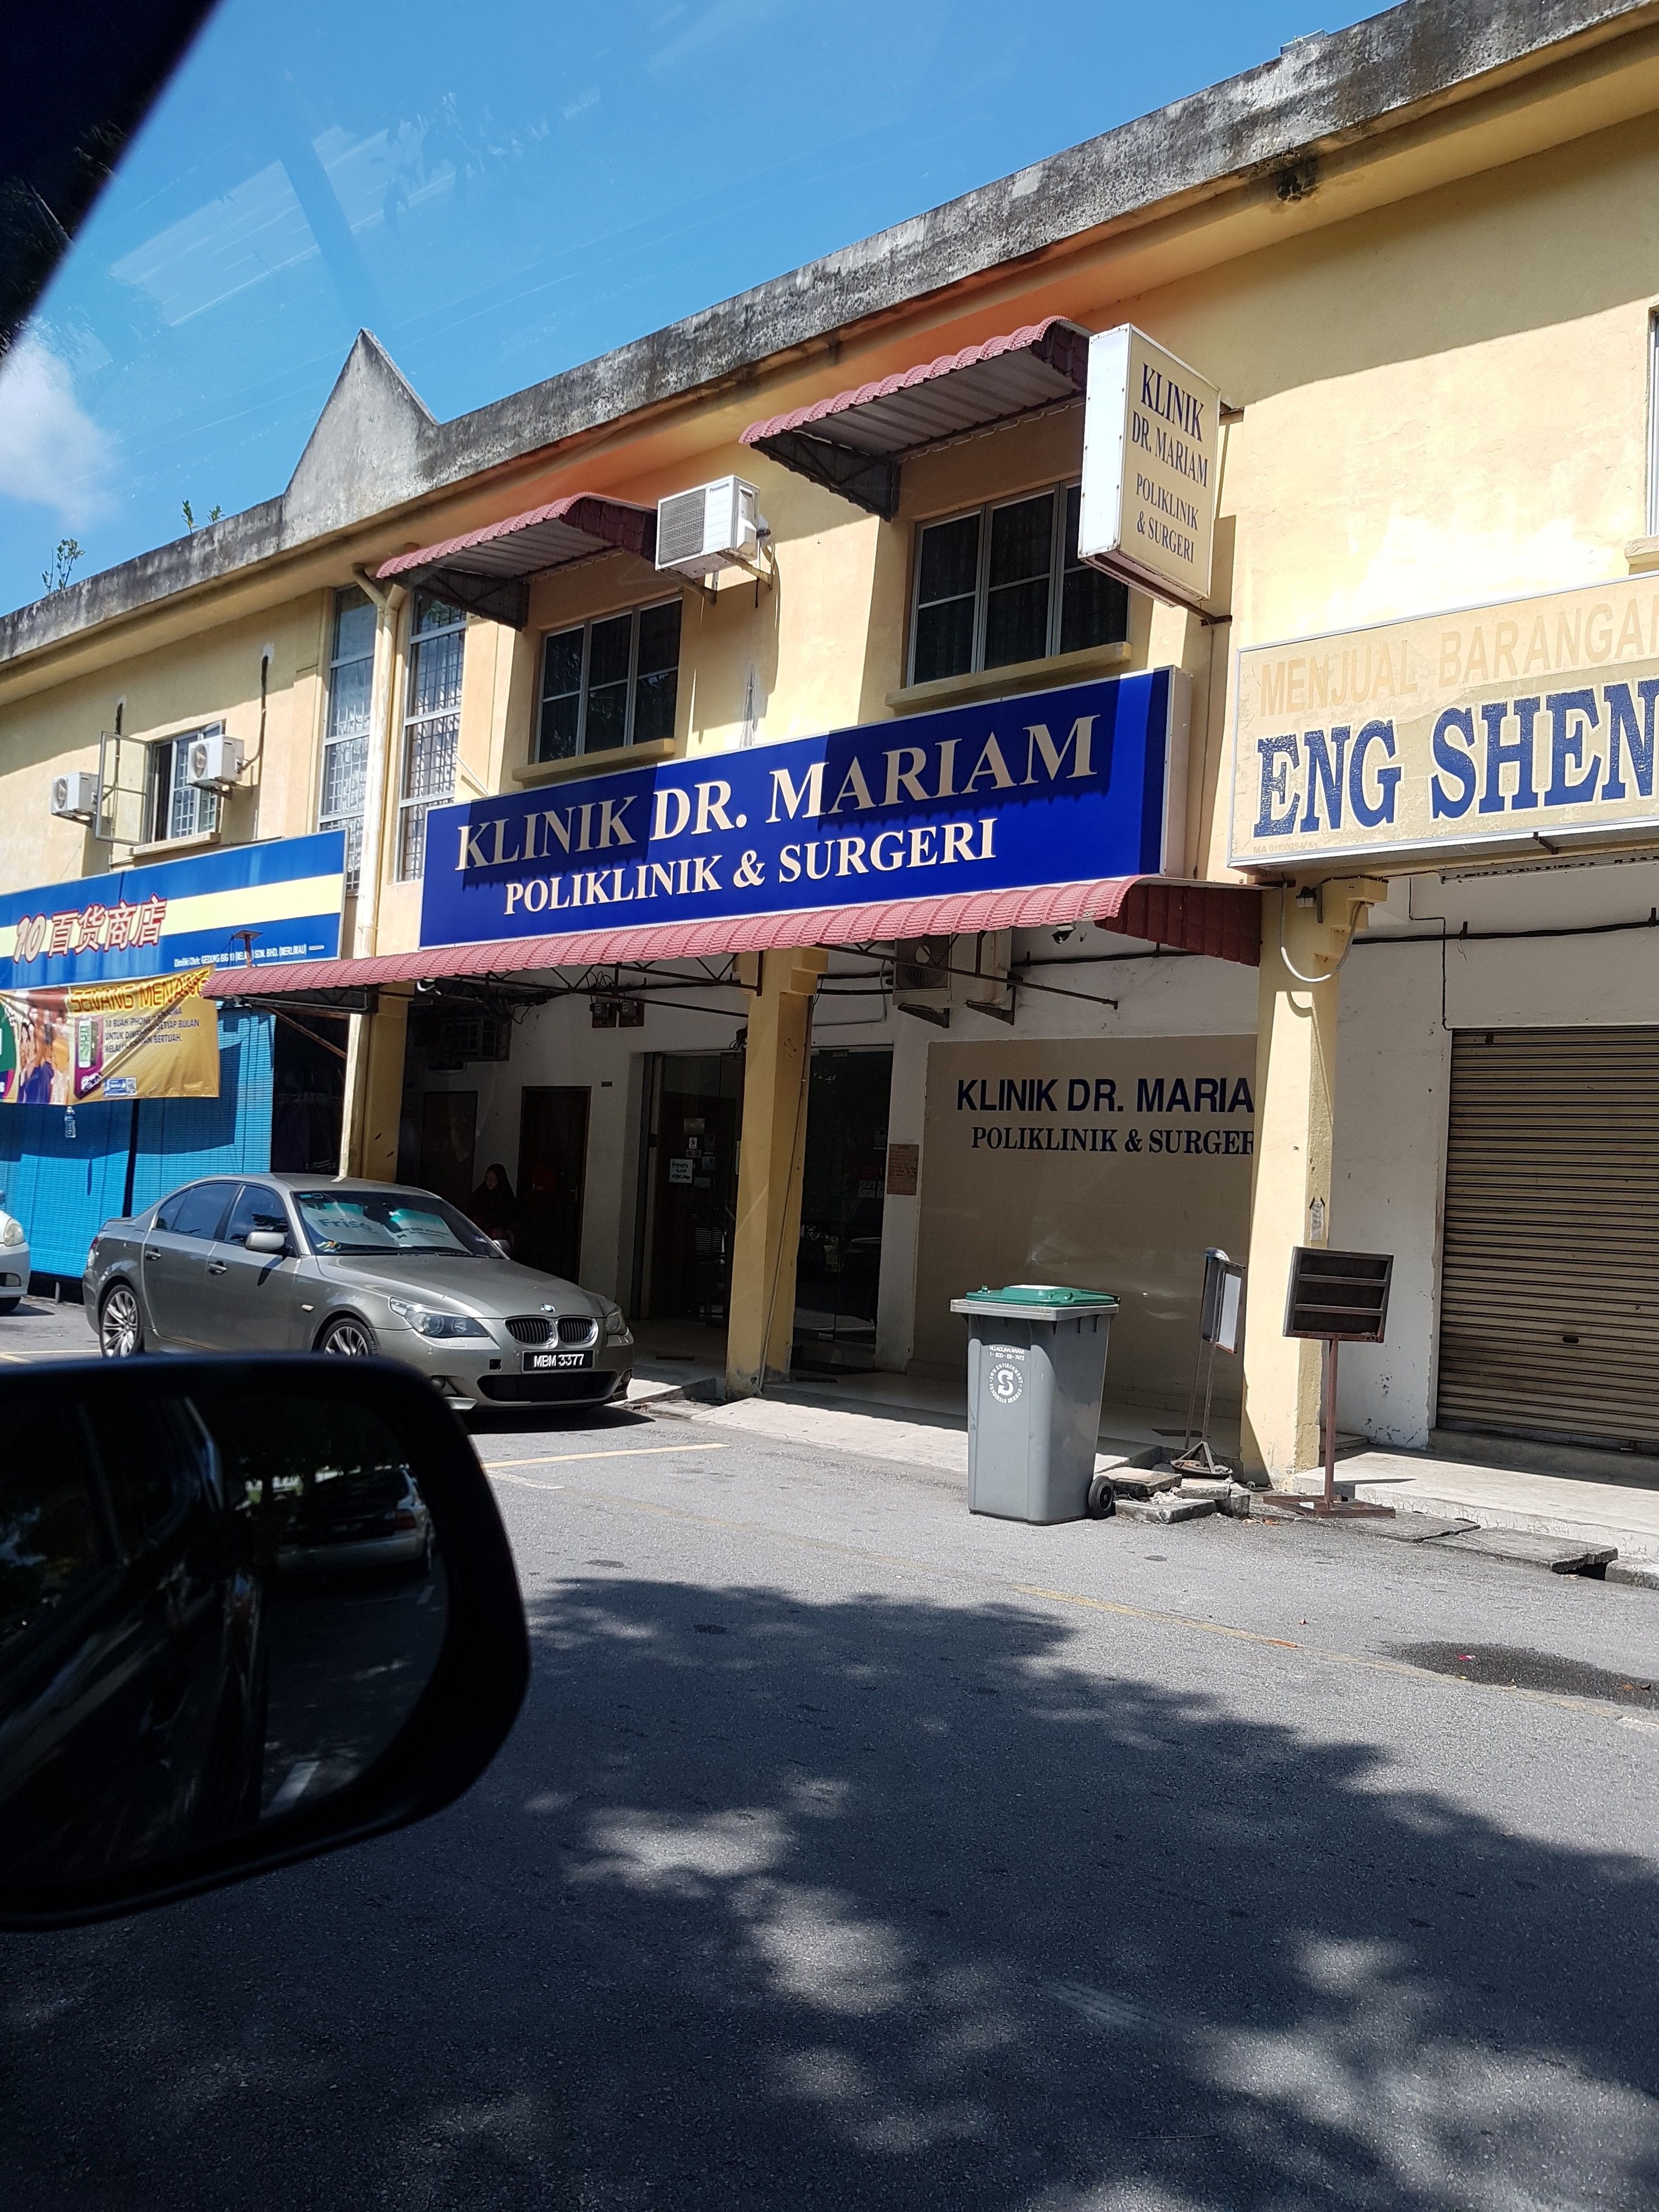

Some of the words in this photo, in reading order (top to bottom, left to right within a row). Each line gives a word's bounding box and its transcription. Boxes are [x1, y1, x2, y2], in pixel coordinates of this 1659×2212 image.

[1141, 363, 1204, 442] KLINIK
[1131, 410, 1153, 453] DR.
[1155, 427, 1208, 488] MARIAM
[1136, 472, 1199, 531] POLIKLINIK
[1137, 511, 1146, 535] &
[1148, 520, 1194, 563] SURGERI
[1261, 640, 1418, 716] MENJUAL
[455, 795, 638, 871] KLINIK
[650, 780, 746, 841] DR.
[766, 714, 1101, 824] MARIAM
[1254, 719, 1402, 838] ENG
[1431, 680, 1659, 819] SHEN
[504, 855, 723, 915] POLIKLINIK
[733, 850, 766, 889] &
[779, 818, 998, 883] SURGERI
[70, 985, 136, 1013] SENANG
[957, 1079, 1058, 1111] KLINIK
[1067, 1079, 1124, 1112] DR.
[971, 1126, 1118, 1152] POLIKLINIK
[1125, 1129, 1143, 1153] &
[534, 1355, 556, 1367] MBM
[557, 1354, 584, 1367] 3377
